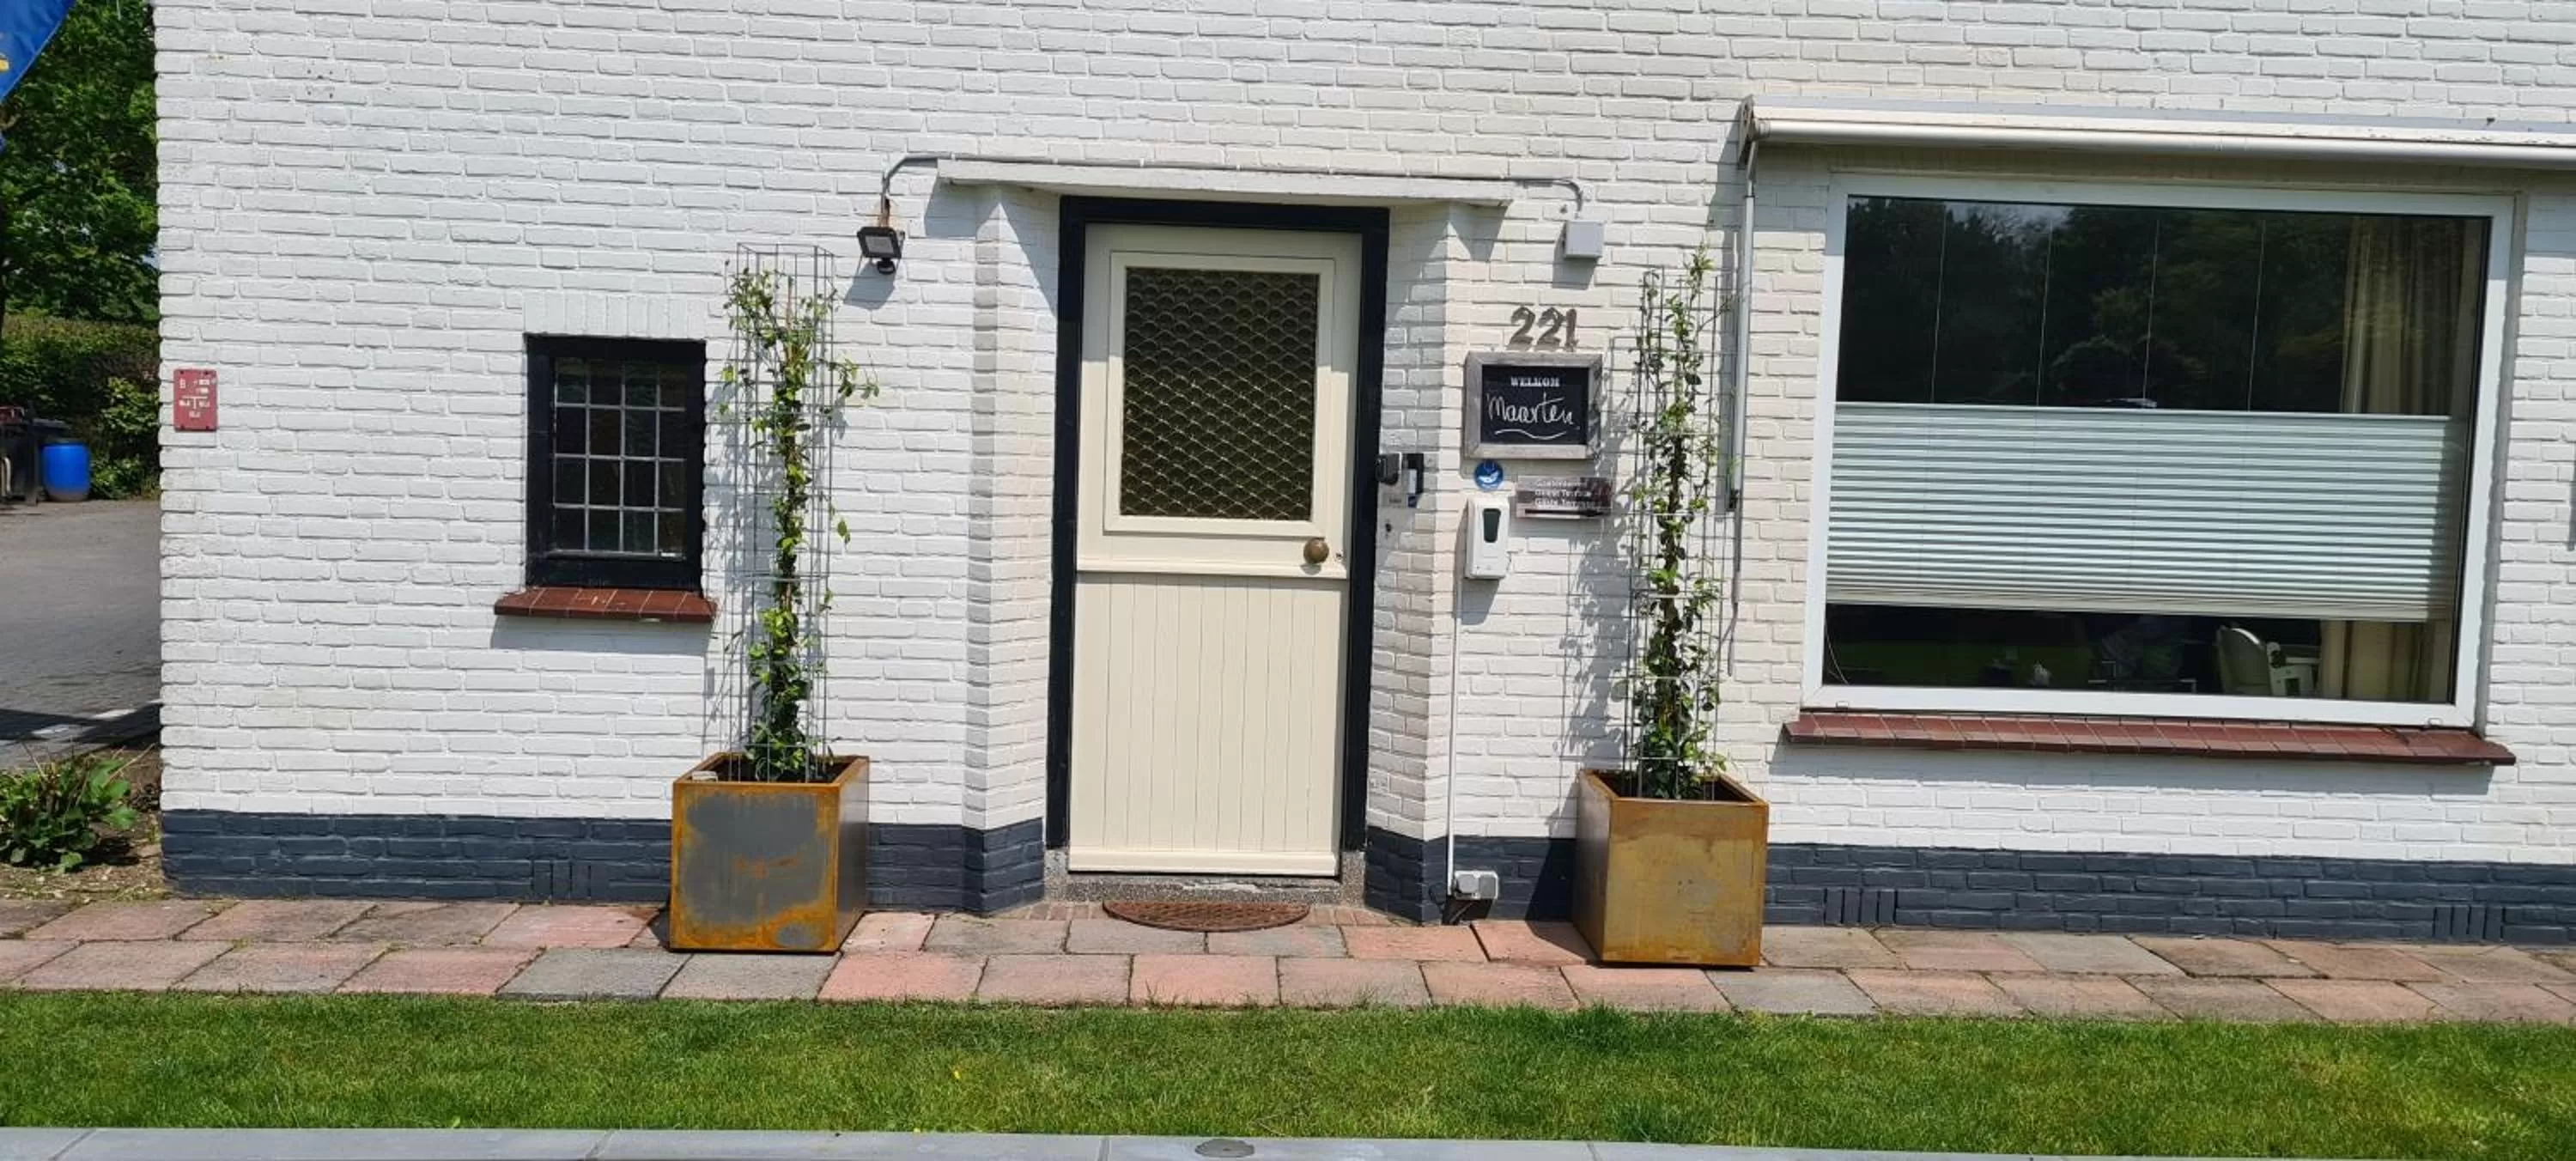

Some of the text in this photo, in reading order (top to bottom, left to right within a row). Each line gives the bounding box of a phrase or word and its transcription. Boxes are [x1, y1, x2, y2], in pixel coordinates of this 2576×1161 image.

[1509, 307, 1578, 351] 221
[1510, 376, 1560, 387] WELKOM
[1486, 392, 1574, 425] Maarten
